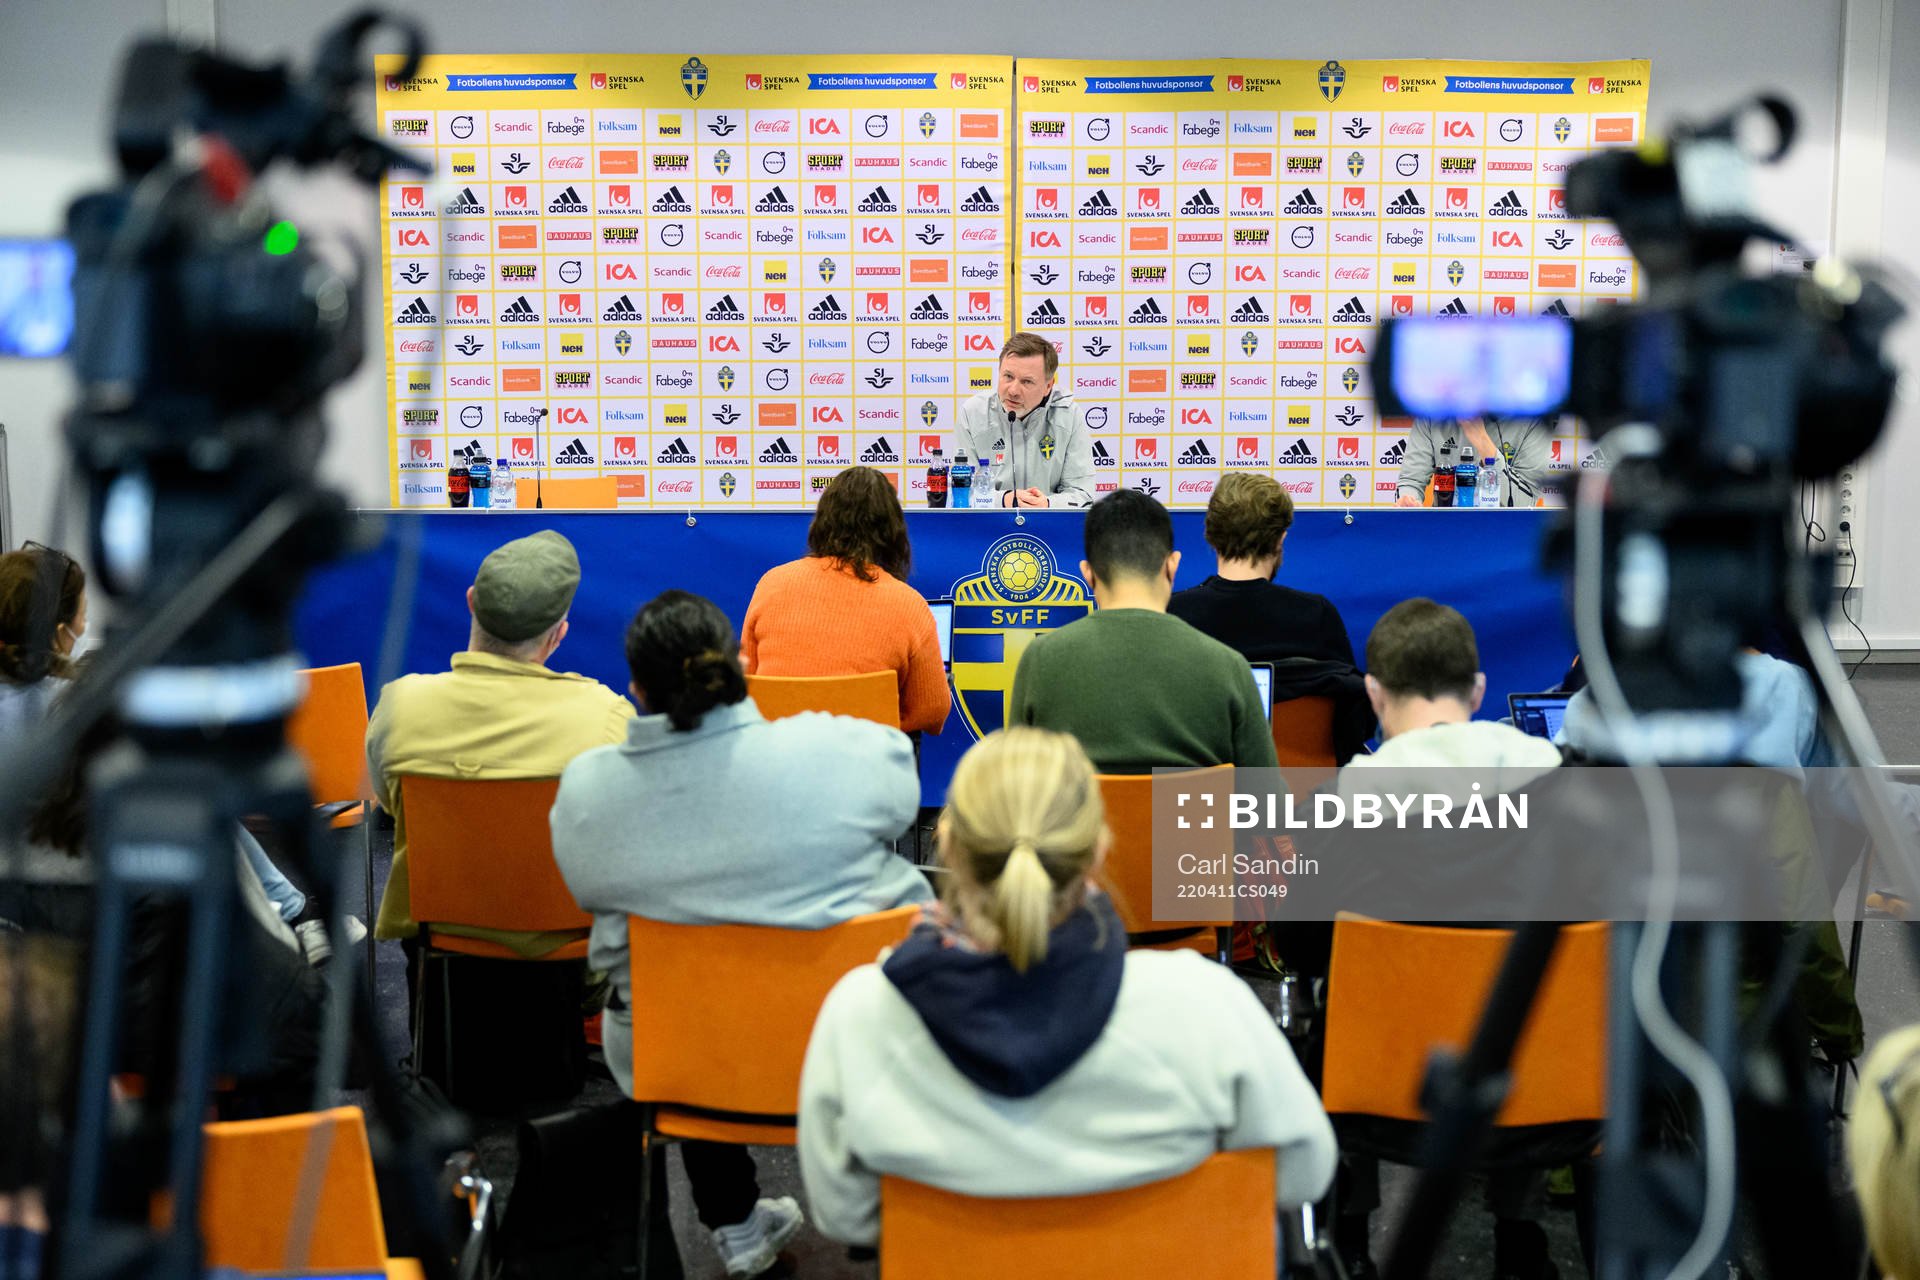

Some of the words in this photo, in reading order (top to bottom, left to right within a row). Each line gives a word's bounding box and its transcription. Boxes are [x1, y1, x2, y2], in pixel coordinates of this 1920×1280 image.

[457, 78, 502, 87] Fotbollens
[504, 78, 566, 87] huvudsponsor
[818, 77, 863, 86] Fotbollens
[865, 77, 926, 87] huvudsponsor
[1095, 80, 1140, 89] Fotbollens
[1142, 80, 1203, 90] huvudsponsor
[1455, 80, 1500, 90] Fotbollens
[1502, 80, 1563, 91] huvudsponsor
[393, 120, 427, 131] SPORT
[717, 116, 727, 125] SJ
[495, 122, 532, 132] Scandic
[548, 122, 584, 135] Fabege
[599, 121, 637, 131] Folksam
[810, 118, 840, 134] ICA
[1131, 124, 1168, 134] Scandic
[1183, 124, 1220, 137] Fabege
[1234, 124, 1272, 133] Folksam
[1444, 121, 1475, 137] ICA
[510, 153, 521, 163] SJ
[654, 154, 689, 166] SPORT
[808, 155, 843, 166] SPORT
[855, 158, 899, 166] BAUHAUS
[1441, 157, 1476, 169] SPORT
[962, 158, 998, 171] Fabege
[1029, 161, 1067, 170] Folksam
[549, 203, 587, 213] adidas
[755, 203, 793, 212] adidas
[1079, 206, 1117, 216] adidas
[1284, 205, 1322, 214] adidas
[1489, 207, 1527, 216] adidas
[925, 224, 935, 234] SJ
[1555, 229, 1565, 239] SJ
[447, 232, 484, 242] Scandic
[547, 232, 591, 240] BAUHAUS
[705, 231, 742, 240] Scandic
[863, 227, 894, 243] ICA
[1031, 232, 1061, 247] ICA
[1079, 234, 1116, 243] Scandic
[1178, 233, 1222, 242] BAUHAUS
[1234, 229, 1269, 240] SPORT
[1335, 233, 1372, 242] Scandic
[1386, 233, 1423, 246] Fabege
[1438, 233, 1475, 242] Folksam
[1493, 231, 1523, 247] ICA
[606, 264, 637, 280] ICA
[962, 267, 999, 280] Fabege
[1040, 265, 1050, 275] SJ
[1131, 267, 1166, 278] SPORT
[1283, 269, 1320, 278] Scandic
[449, 269, 485, 283] Fabege
[1079, 271, 1115, 284] Fabege
[1484, 271, 1528, 280] BAUHAUS
[1590, 272, 1626, 286] Fabege
[500, 313, 539, 322] adidas
[808, 311, 847, 320] adidas
[1027, 315, 1065, 324] adidas
[1231, 313, 1269, 322] adidas
[772, 333, 782, 343] SJ
[965, 335, 995, 351] ICA
[1092, 336, 1102, 346] SJ
[502, 341, 540, 350] Folksam
[652, 339, 696, 348] BAUHAUS
[710, 336, 740, 352] ICA
[809, 339, 846, 348] Folksam
[1129, 342, 1167, 351] Folksam
[1335, 338, 1366, 353] ICA
[450, 376, 491, 386] Scandic
[556, 372, 590, 384] SPORT
[605, 375, 642, 385] Scandic
[656, 375, 692, 388] Fabege
[1230, 376, 1267, 386] Scandic
[1281, 376, 1317, 390] Fabege
[722, 404, 732, 414] SJ
[859, 409, 899, 418] Scandic
[404, 410, 438, 421] SPORT
[606, 411, 644, 420] Folksam
[813, 407, 843, 423] ICA
[1129, 412, 1165, 426] Fabege
[1182, 408, 1212, 424] ICA
[1229, 411, 1267, 420] Folksam
[556, 455, 594, 464] adidas
[860, 453, 899, 462] adidas
[1279, 455, 1317, 464] adidas
[756, 481, 800, 489] BAUHAUS
[1141, 478, 1152, 488] SJ
[404, 484, 442, 493] Folksam
[990, 556, 1004, 592] SVENSKA
[999, 541, 1048, 593] FOTBOLLFÖRBUNDET
[992, 609, 1050, 625] SvFF
